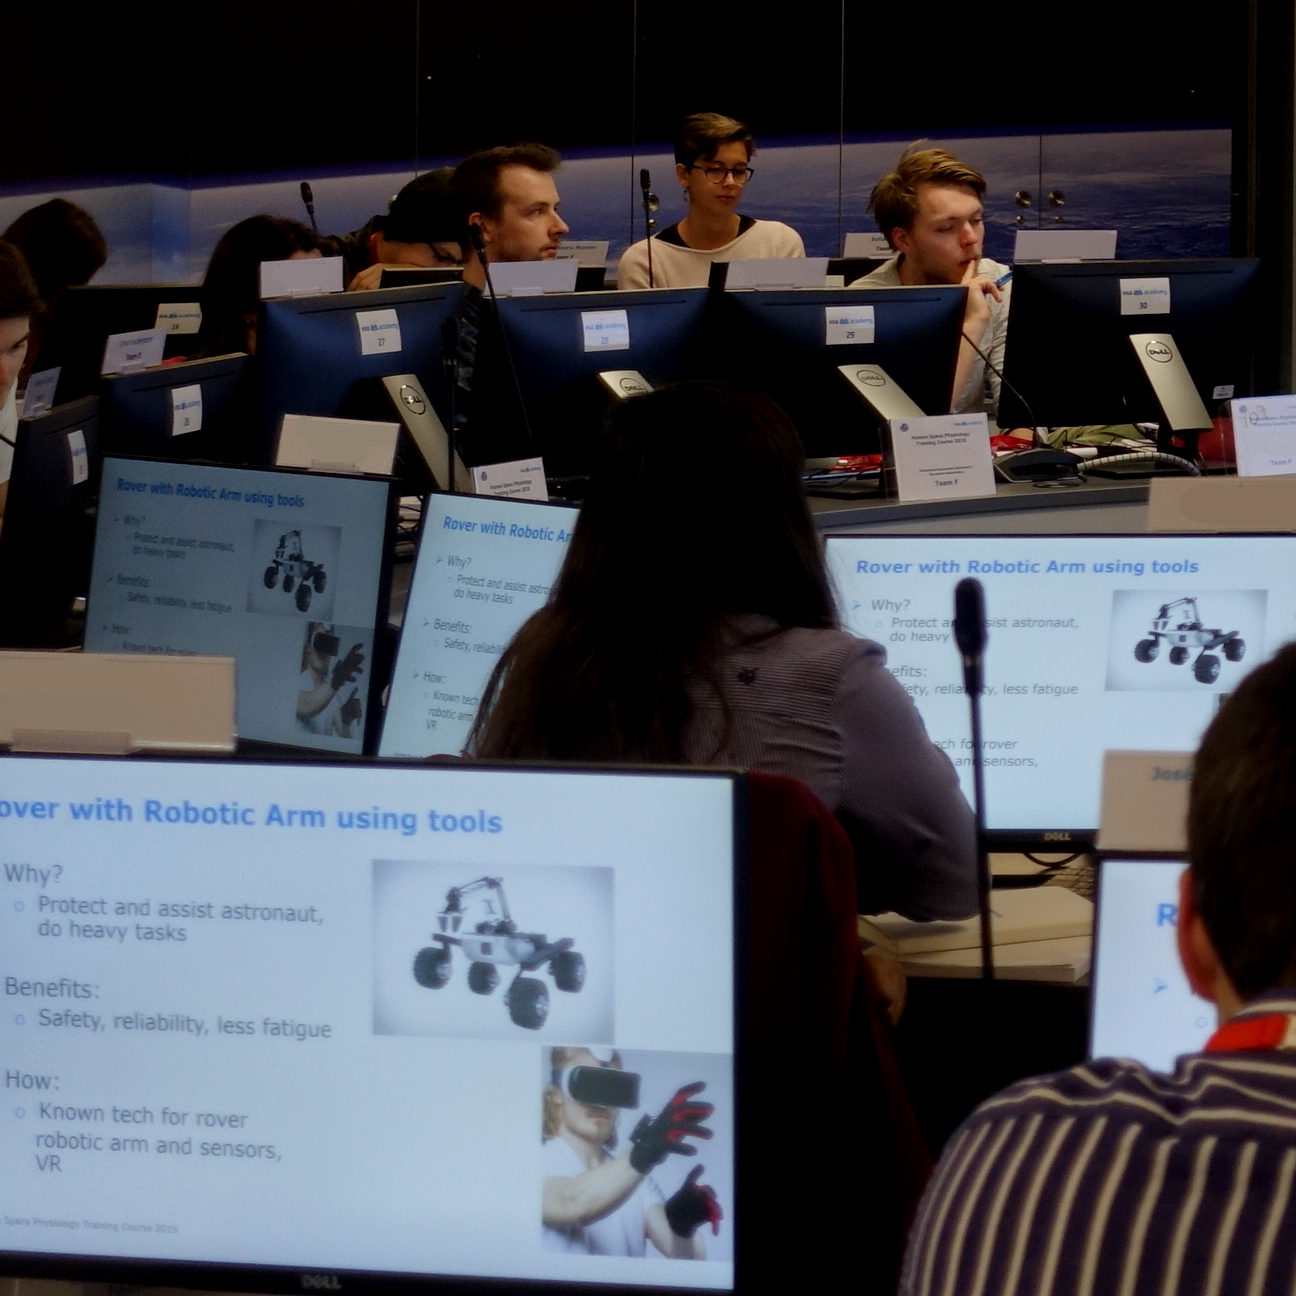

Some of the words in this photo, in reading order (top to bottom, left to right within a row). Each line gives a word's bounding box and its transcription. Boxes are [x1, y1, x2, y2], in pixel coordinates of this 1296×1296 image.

[1139, 302, 1148, 310] 30
[0, 799, 60, 819] over
[69, 797, 133, 822] with
[144, 799, 256, 826] Robotic
[264, 803, 326, 828] Arm
[336, 805, 417, 836] using
[427, 809, 502, 833] tools
[1045, 832, 1071, 842] DELL
